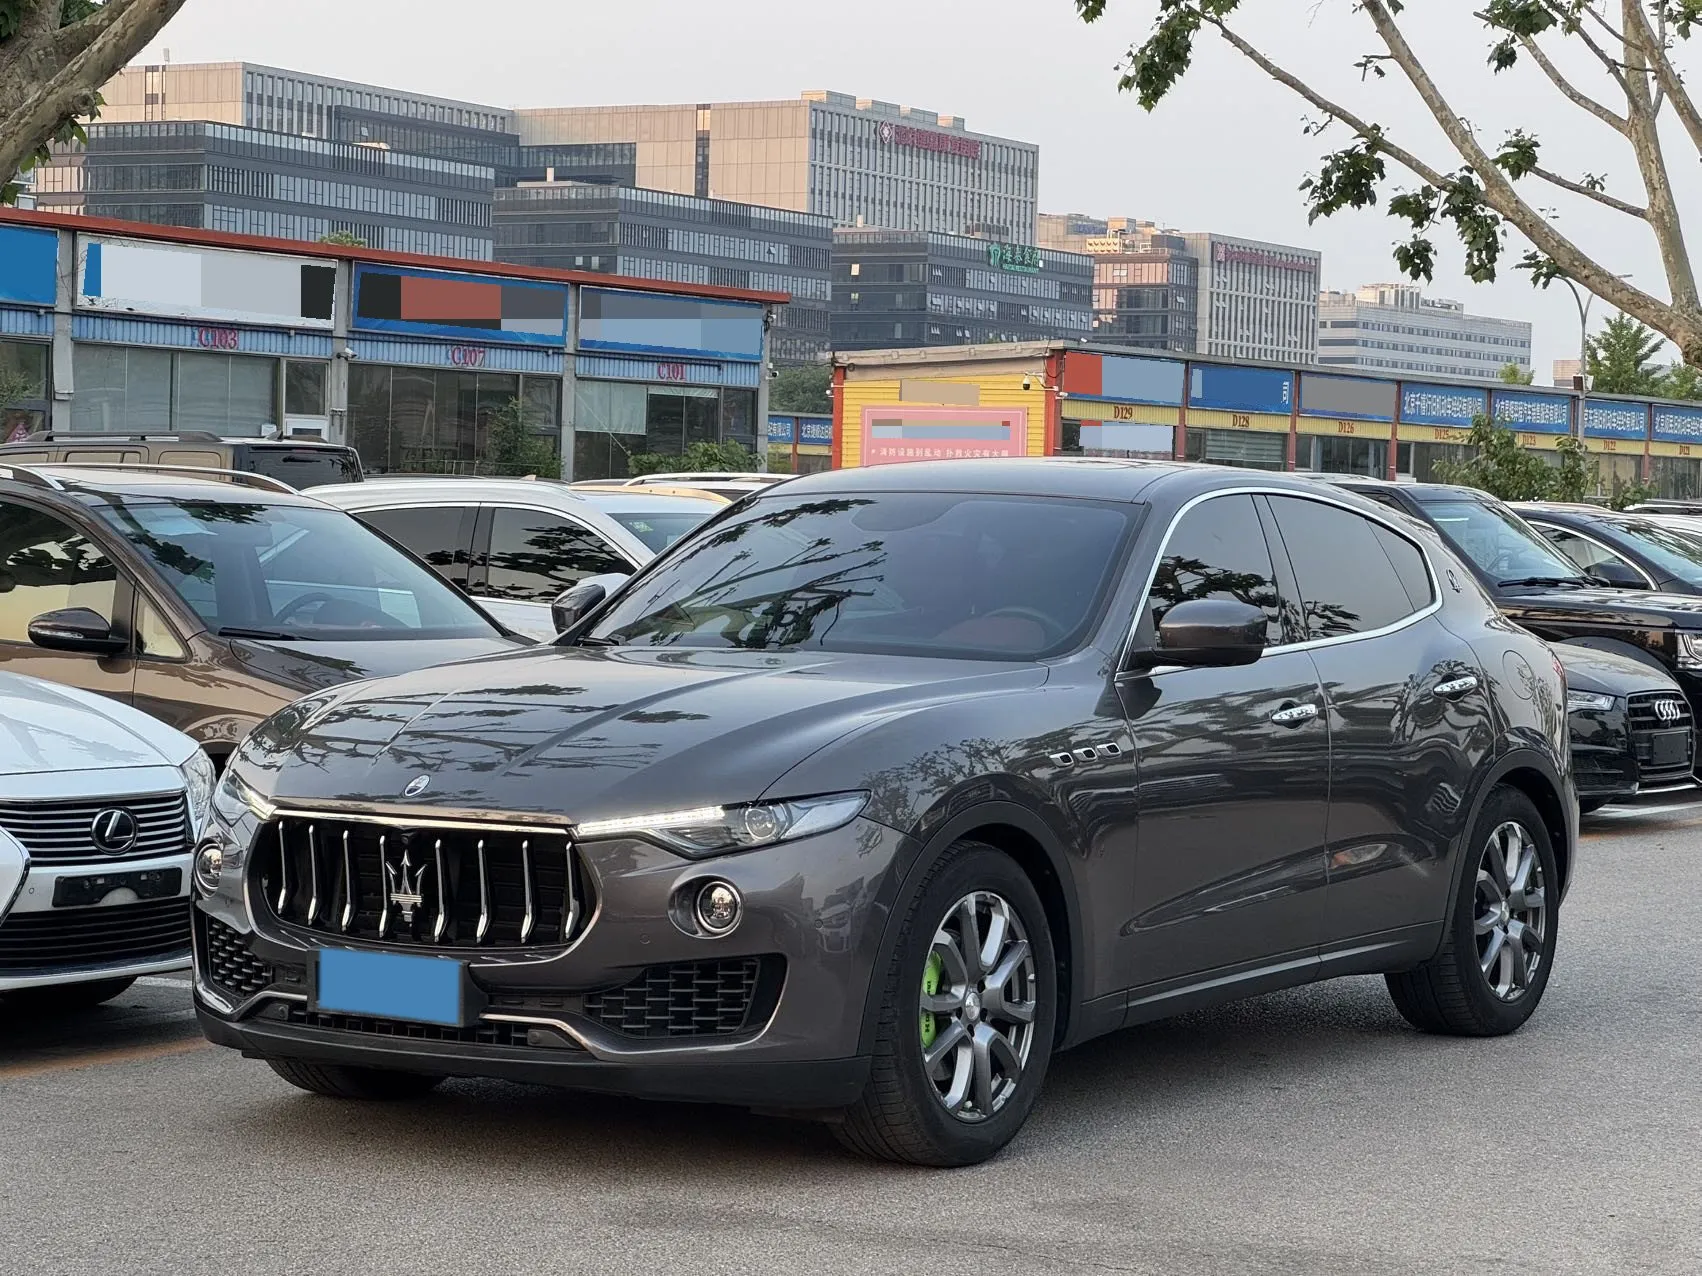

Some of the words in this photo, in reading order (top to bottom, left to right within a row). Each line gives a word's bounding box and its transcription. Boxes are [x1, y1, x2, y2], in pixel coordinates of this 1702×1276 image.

[452, 346, 485, 367] C107
[1113, 405, 1133, 420] D129
[1232, 414, 1250, 428] D128
[1338, 421, 1355, 434] D126
[1522, 433, 1536, 446] D123
[1603, 439, 1617, 451] D122
